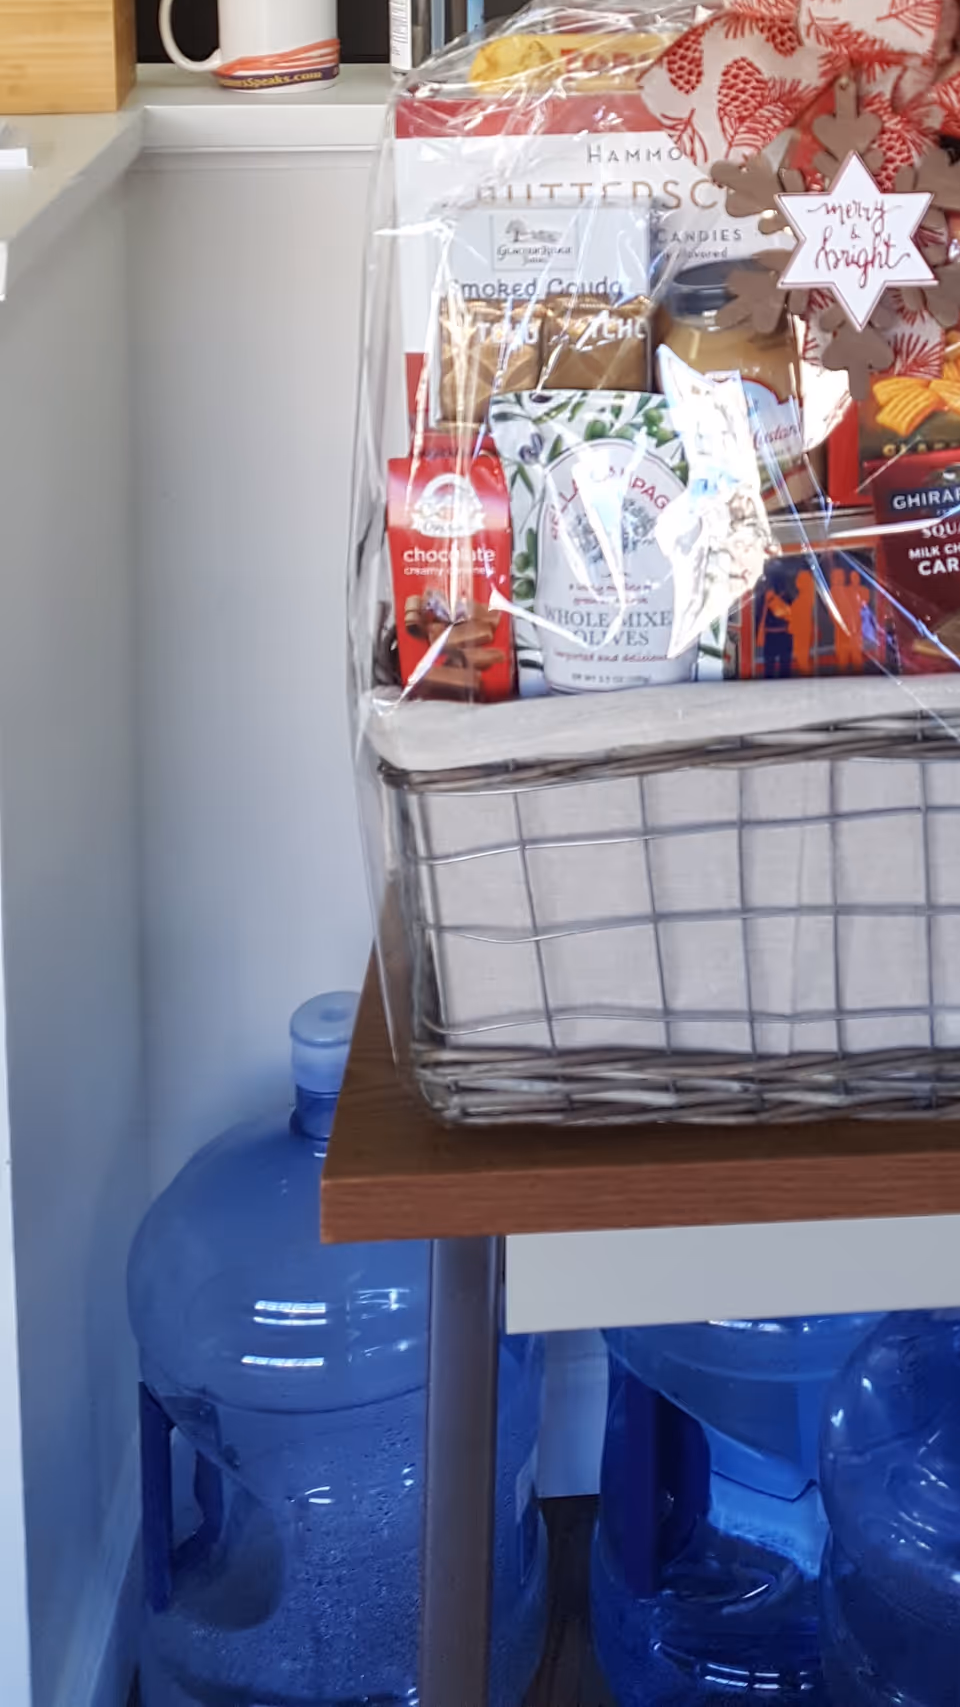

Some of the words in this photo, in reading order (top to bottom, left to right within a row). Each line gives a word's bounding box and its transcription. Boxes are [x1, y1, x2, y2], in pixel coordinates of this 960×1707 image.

[587, 145, 683, 163] HAMMO
[476, 180, 718, 210] BUTTERSC
[807, 200, 902, 236] merry
[815, 226, 910, 288] bright
[908, 546, 940, 560] MILK
[622, 609, 673, 628] MIXE
